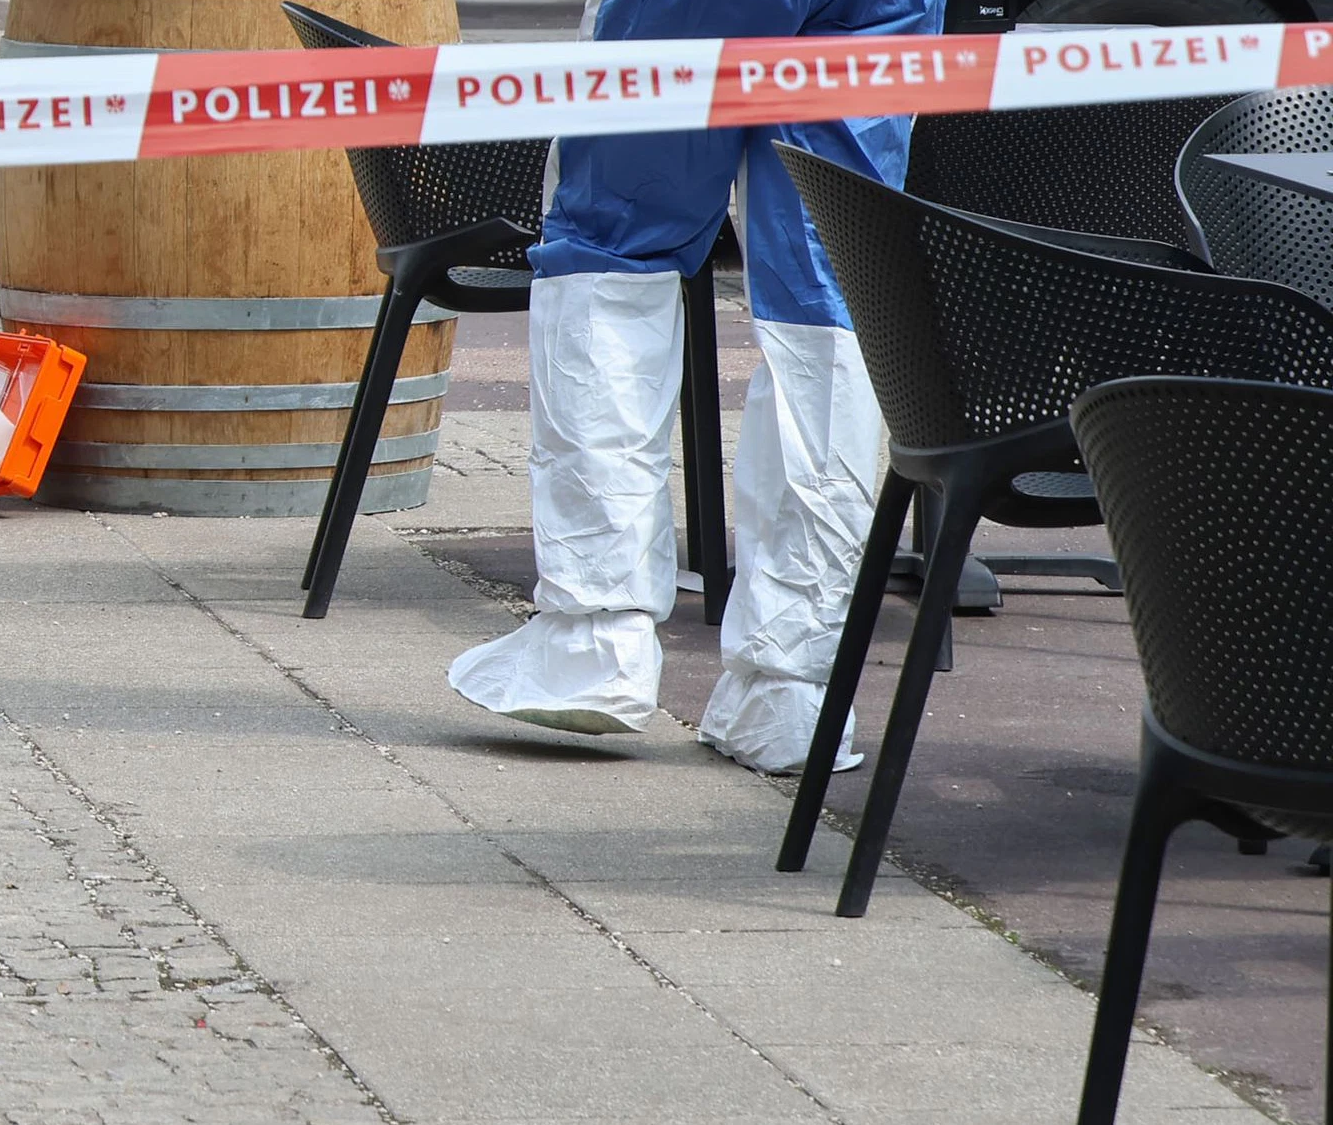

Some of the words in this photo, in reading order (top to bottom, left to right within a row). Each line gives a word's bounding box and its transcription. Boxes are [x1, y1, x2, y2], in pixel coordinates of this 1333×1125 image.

[172, 79, 377, 124] POLIZEI
[457, 66, 661, 108] POLIZEI
[739, 50, 946, 94] POLIZEI
[1023, 36, 1227, 75] POLIZEI
